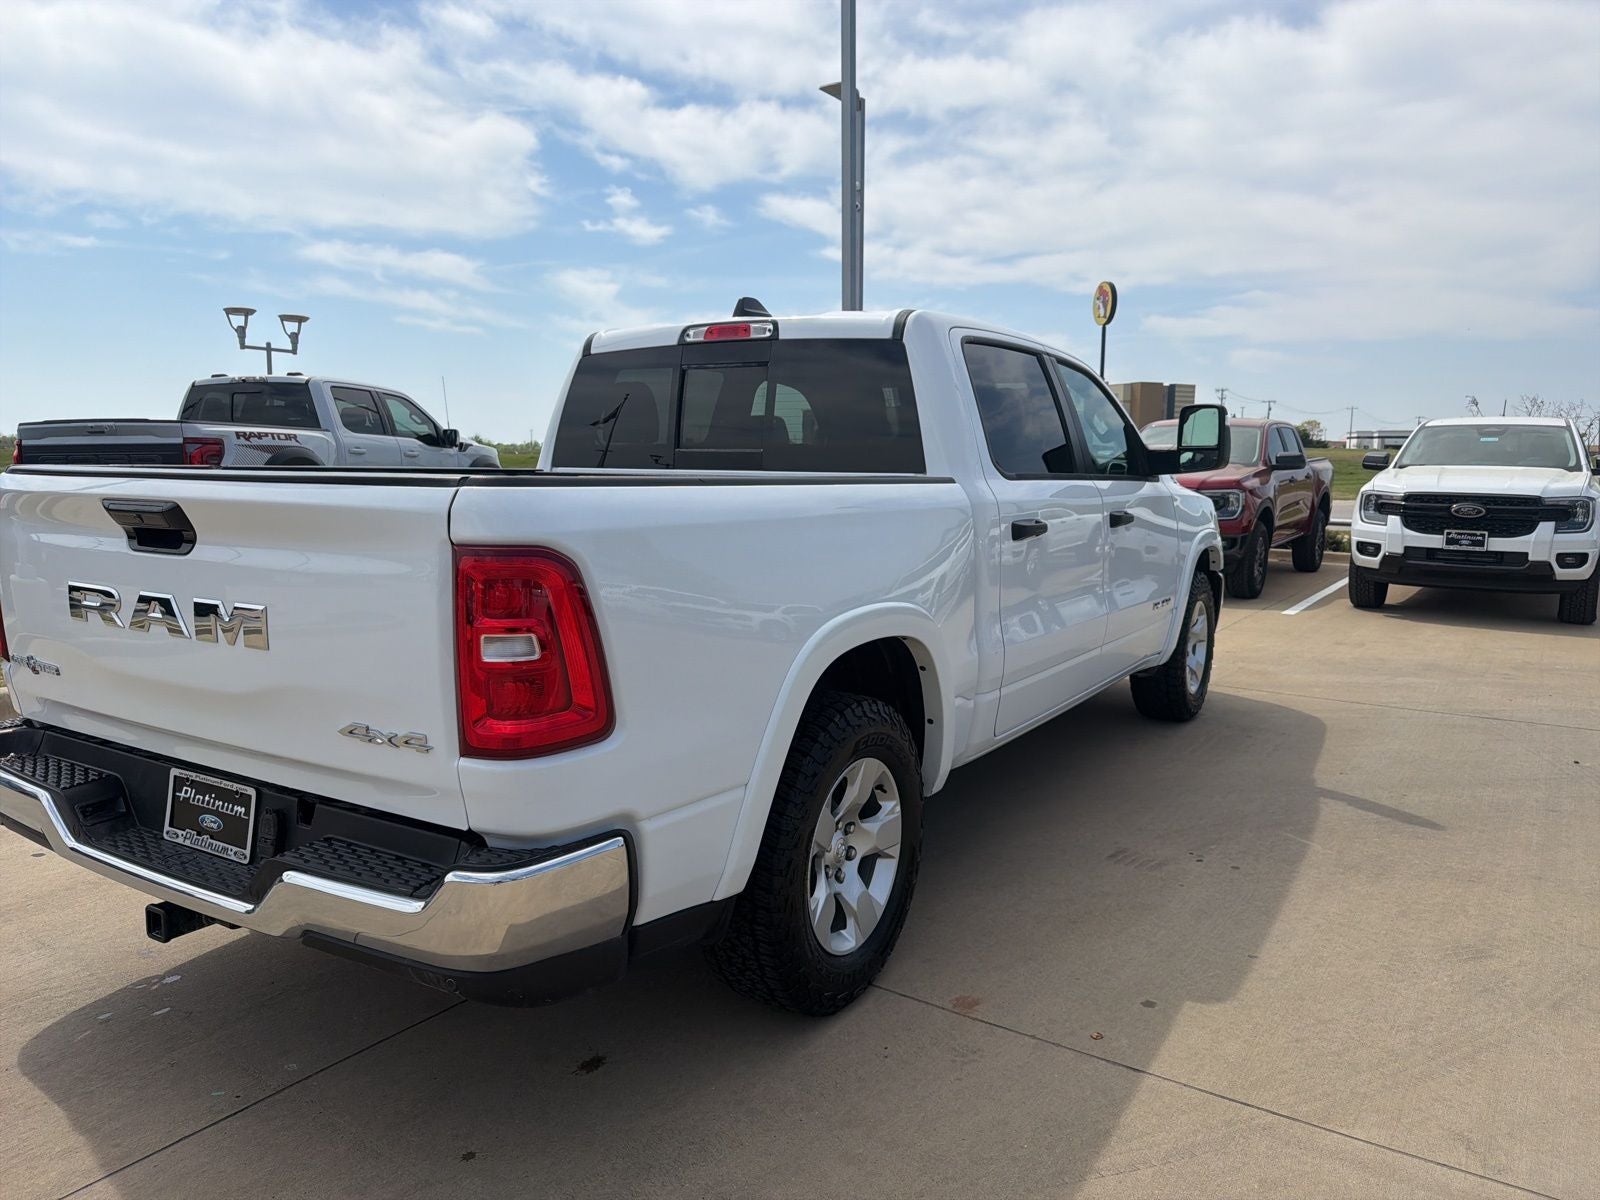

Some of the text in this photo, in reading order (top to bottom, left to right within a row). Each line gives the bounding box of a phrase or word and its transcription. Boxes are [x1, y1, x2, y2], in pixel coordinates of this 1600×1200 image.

[235, 431, 303, 445] RAPTOR
[1448, 533, 1484, 541] Platinum
[67, 580, 270, 651] RAM
[176, 786, 249, 819] Platinum
[202, 816, 220, 830] Ford
[183, 830, 231, 856] Platinum
